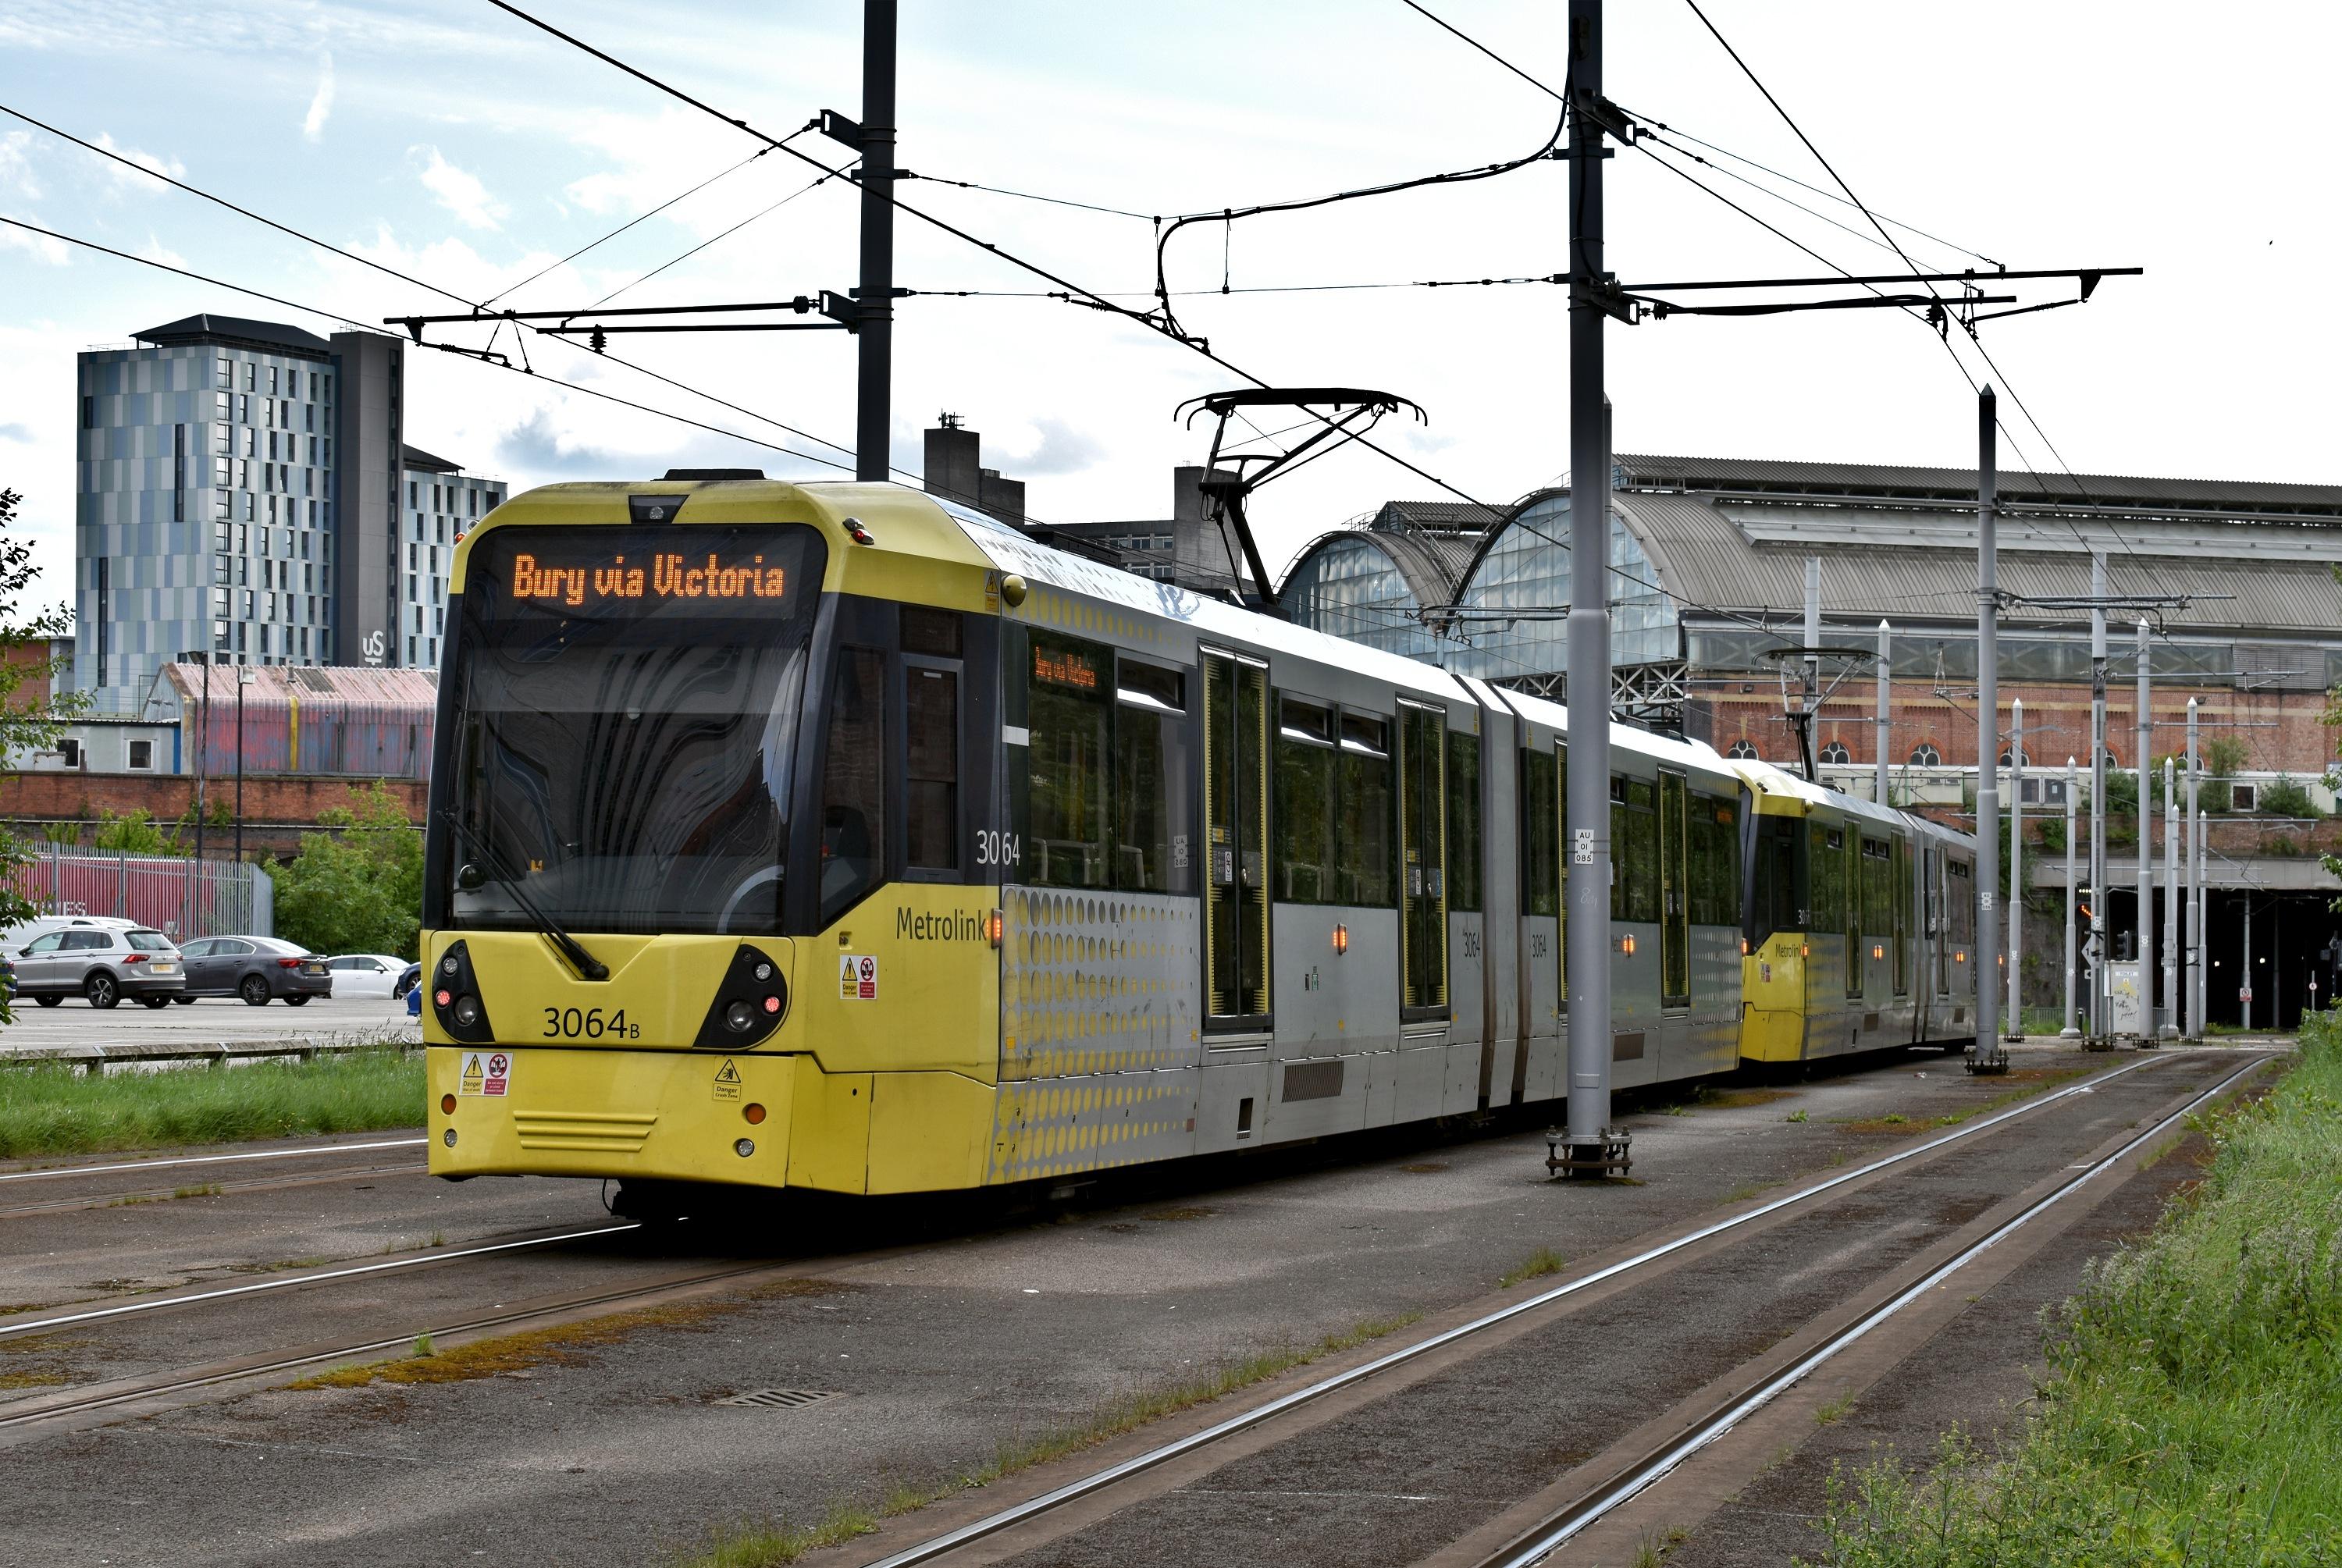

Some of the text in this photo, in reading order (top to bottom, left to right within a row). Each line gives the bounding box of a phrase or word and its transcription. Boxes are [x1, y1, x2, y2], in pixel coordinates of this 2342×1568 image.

[514, 554, 784, 605] Bury via Victoria
[977, 830, 1020, 866] 3064
[896, 906, 988, 941] Metrolink
[1464, 932, 1481, 958] 3064
[1532, 934, 1547, 958] 3064
